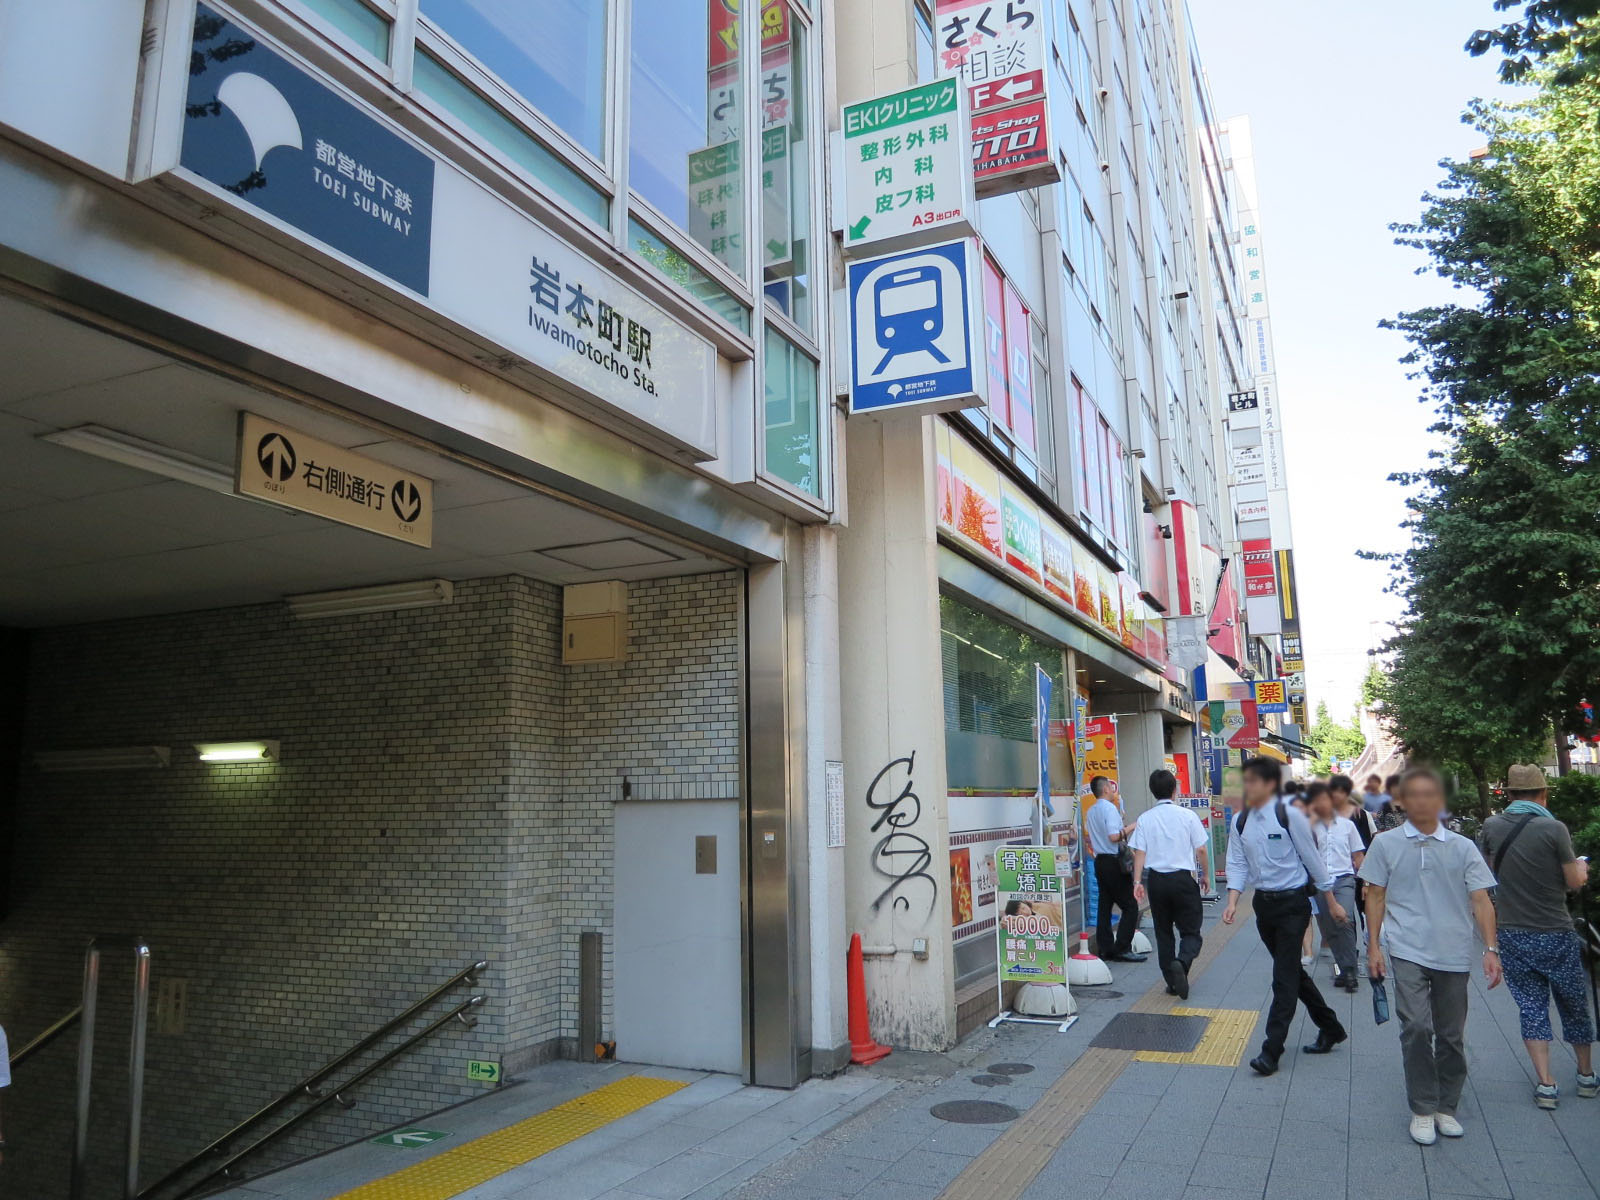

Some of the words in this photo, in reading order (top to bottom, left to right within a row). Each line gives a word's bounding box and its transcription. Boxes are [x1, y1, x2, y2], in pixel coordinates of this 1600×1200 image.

[941, 0, 1034, 48] さくら
[955, 40, 1026, 81] 相談
[847, 86, 955, 133] EKIクリニック
[997, 115, 1040, 131] Shop
[860, 123, 949, 162] 整形外科
[315, 139, 413, 215] 都営地下鉄
[313, 166, 347, 199] TOEI
[353, 191, 411, 236] SUBWAY
[876, 183, 935, 214] 皮フ科
[529, 256, 653, 370] 岩本町駅
[528, 305, 629, 380] Iwamotocho
[633, 367, 659, 398] Sta.
[264, 481, 286, 495] のぼり
[303, 460, 385, 511] 右側通行
[1258, 682, 1281, 704] 薬
[1214, 737, 1225, 747] B1
[1001, 851, 1041, 871] 骨盤
[1016, 873, 1058, 893] 矯正
[1006, 938, 1027, 950] 腰痛
[1006, 950, 1036, 962] 肩こり
